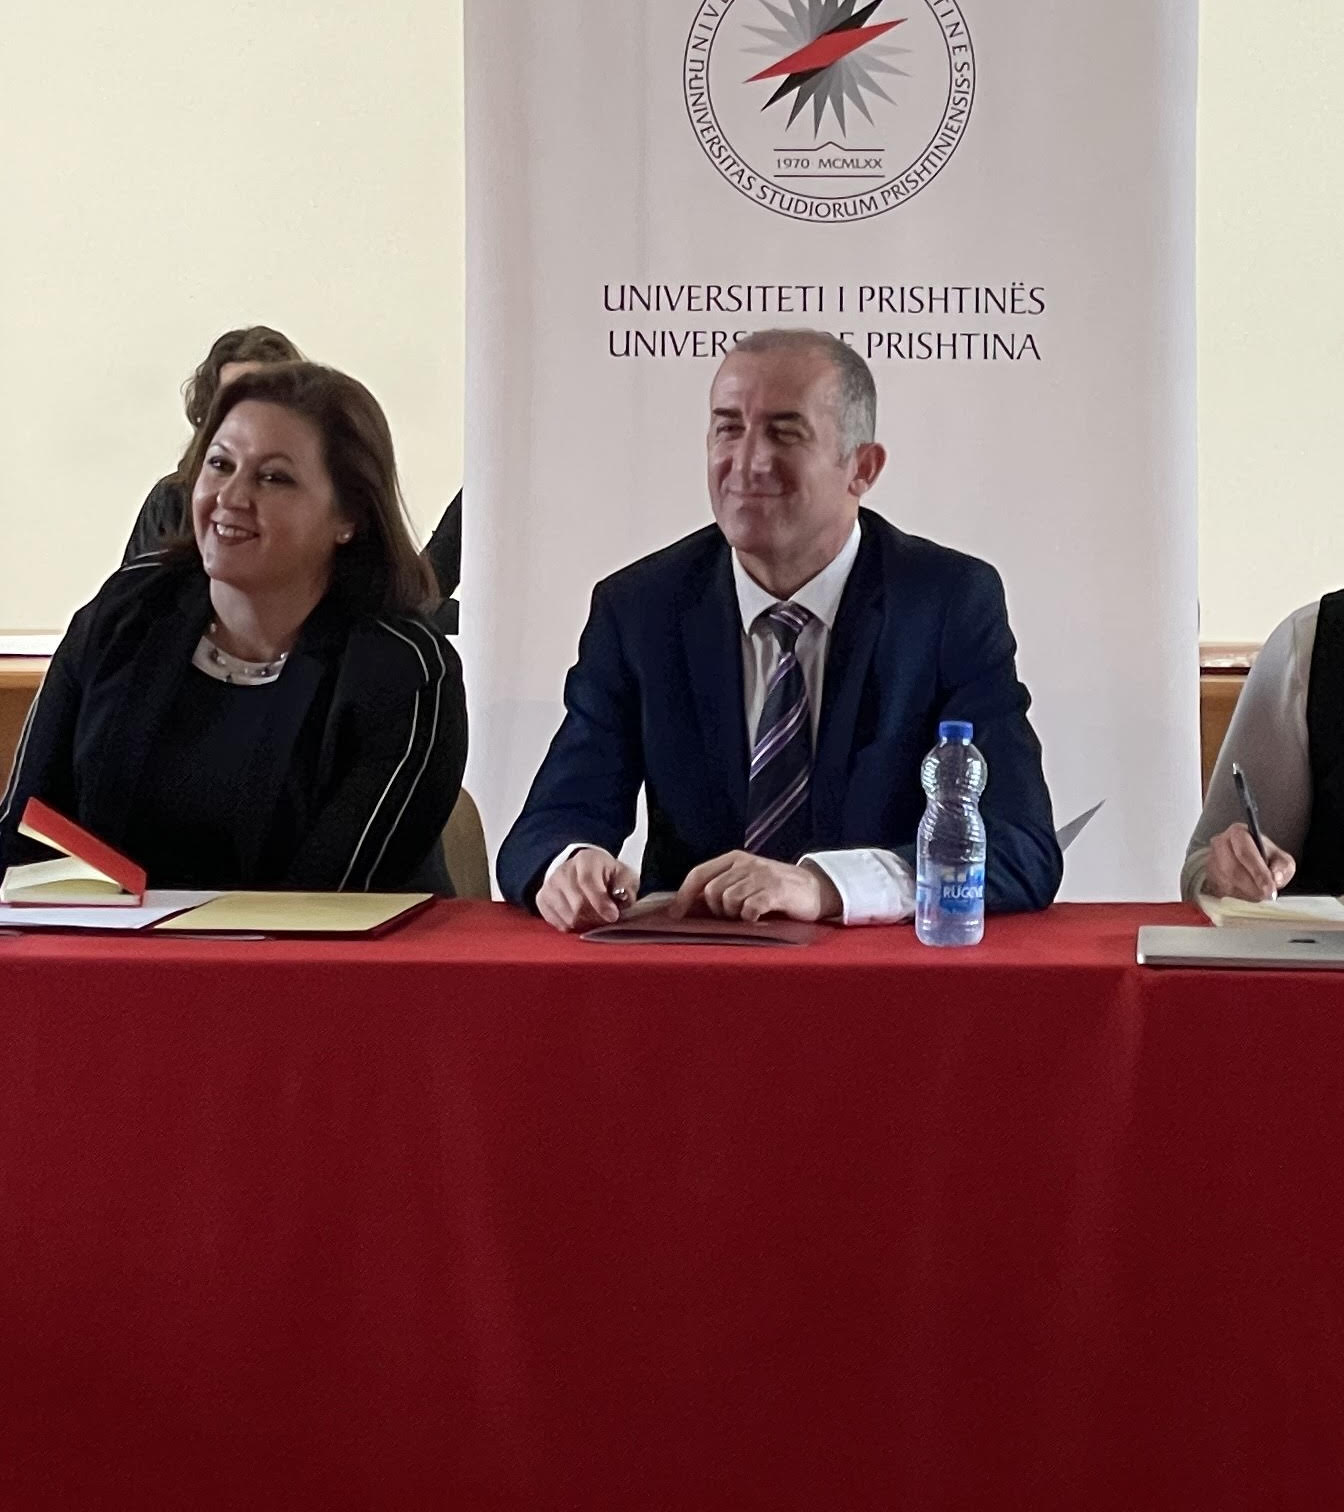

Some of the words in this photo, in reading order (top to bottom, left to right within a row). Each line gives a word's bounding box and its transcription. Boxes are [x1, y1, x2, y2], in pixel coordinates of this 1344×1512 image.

[688, 76, 756, 191] UNIVERSITAS
[756, 184, 879, 219] STUDIORUM
[880, 76, 971, 206] PRISHTINIENSIS
[777, 158, 810, 169] 1970
[818, 158, 882, 169] MCMLXX
[603, 284, 824, 312] UNIVERSITETI
[839, 285, 845, 312] I
[858, 282, 1045, 315] PRISHTINËS
[608, 330, 748, 357] UNIVERS
[867, 332, 1042, 361] PRISHTINA
